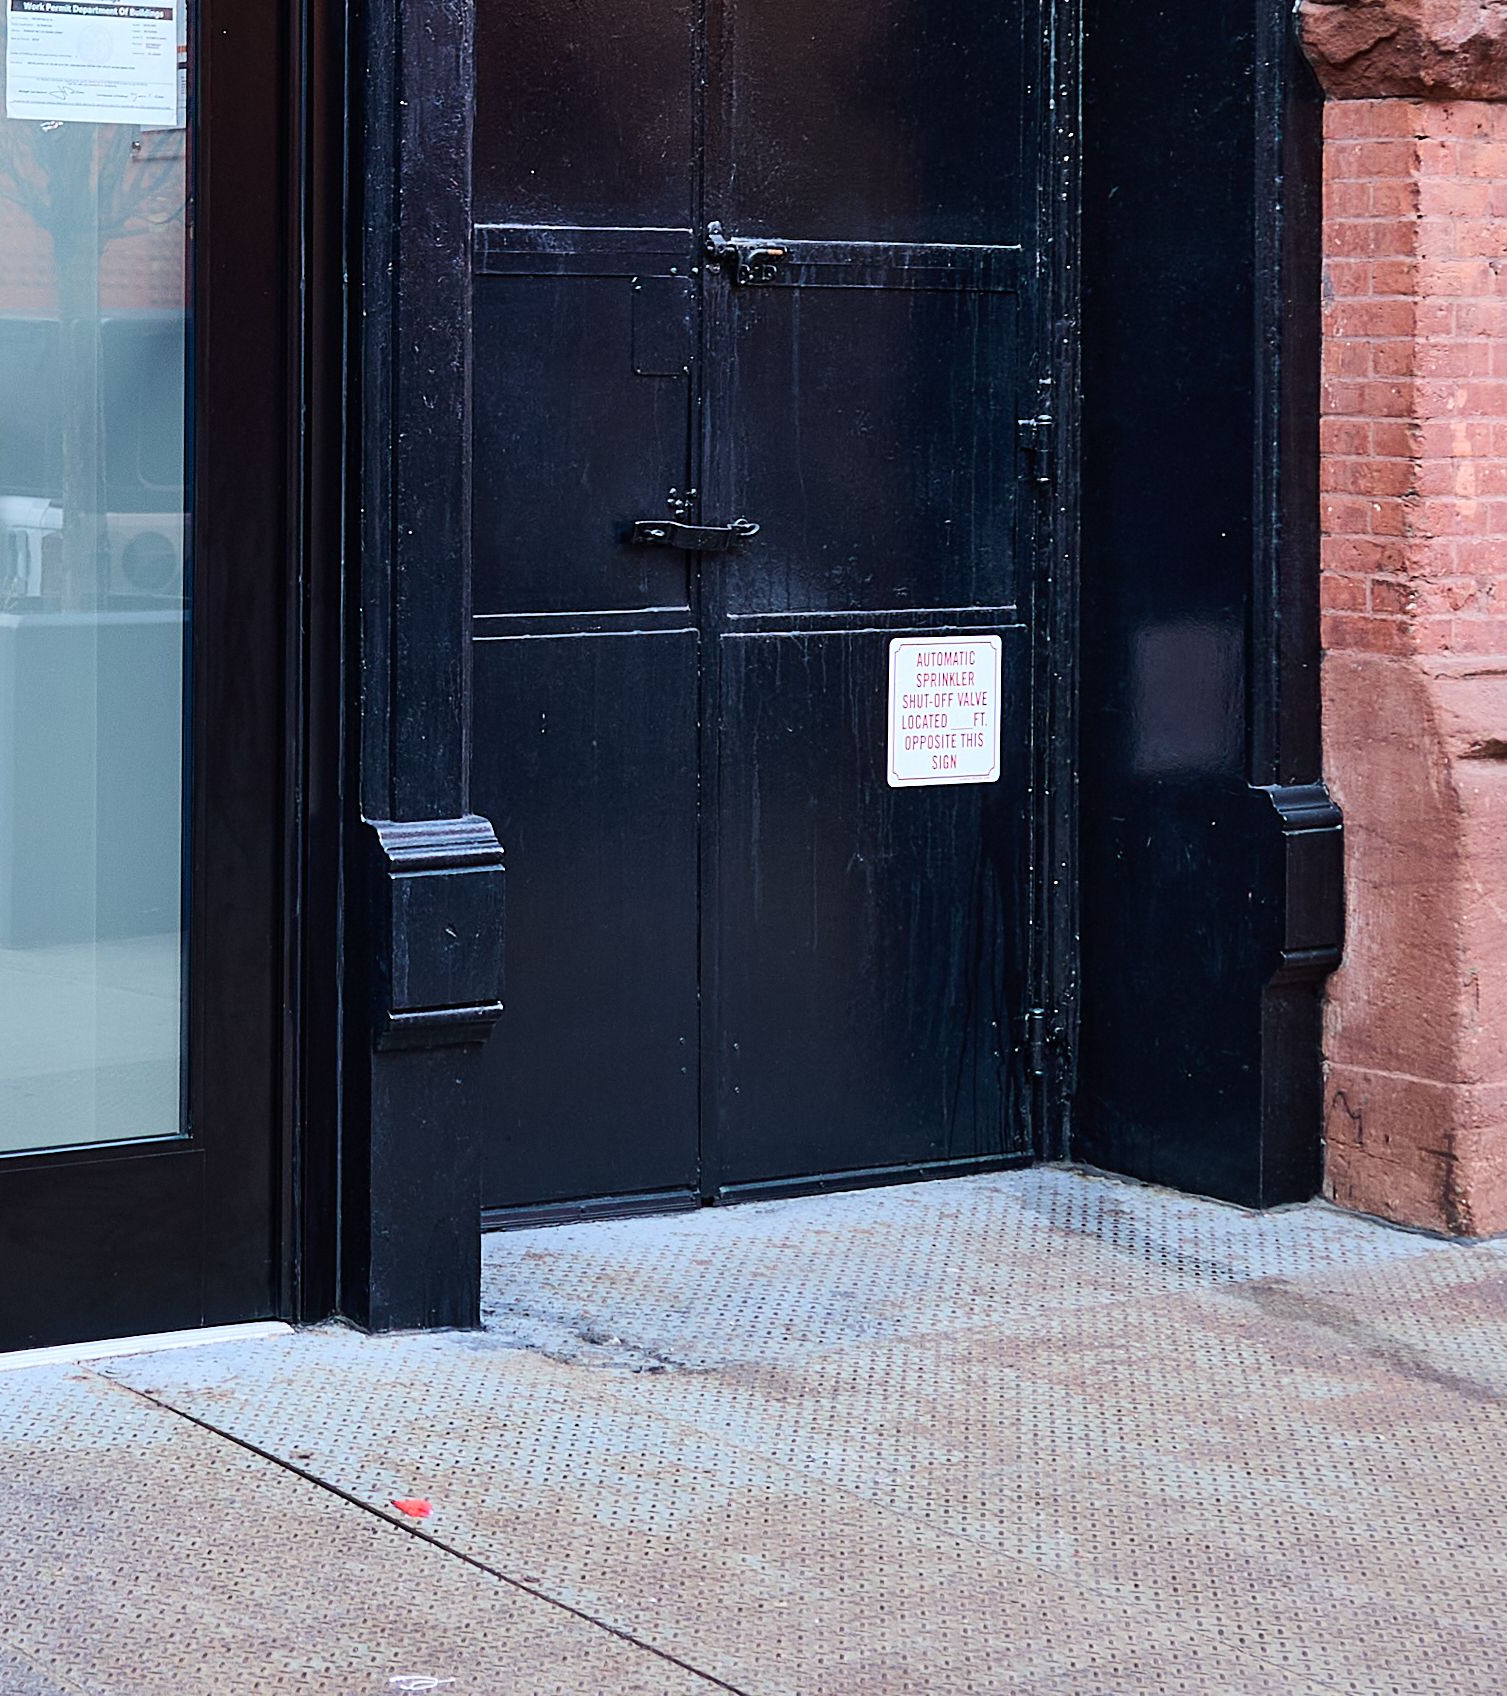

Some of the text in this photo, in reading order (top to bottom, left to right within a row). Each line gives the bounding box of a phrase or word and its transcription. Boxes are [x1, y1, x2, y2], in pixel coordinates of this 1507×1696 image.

[23, 2, 164, 20] Work Permit Department Of Buildings
[916, 651, 976, 667] AUTOMATIC
[916, 672, 975, 688] SPRINKLER
[902, 691, 988, 709] SHUT-OFF VALVE
[902, 712, 987, 730] LOCATED FT.
[905, 733, 984, 751] OPPOSITE THIS
[931, 755, 957, 770] SIGN
